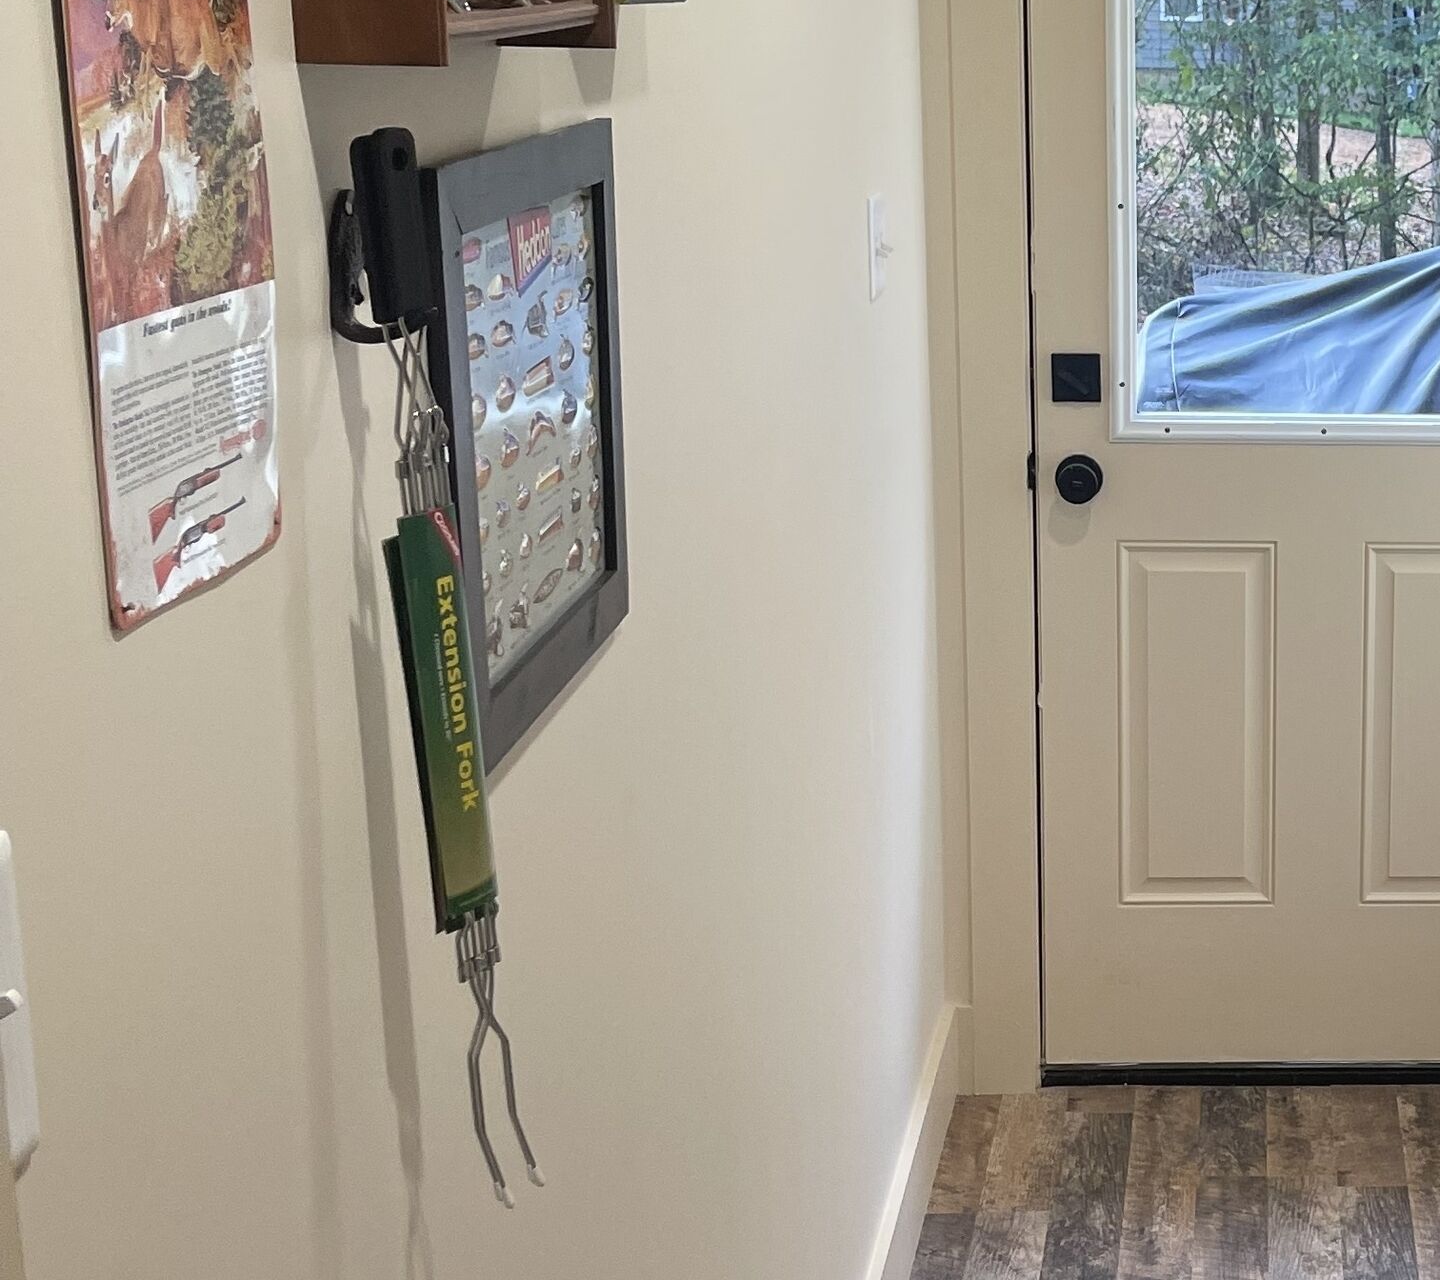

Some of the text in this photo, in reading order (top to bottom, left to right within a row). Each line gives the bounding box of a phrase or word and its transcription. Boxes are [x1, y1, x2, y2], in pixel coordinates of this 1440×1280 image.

[516, 218, 551, 283] Heddon
[436, 574, 468, 734] Extension
[456, 741, 480, 813] Fork
